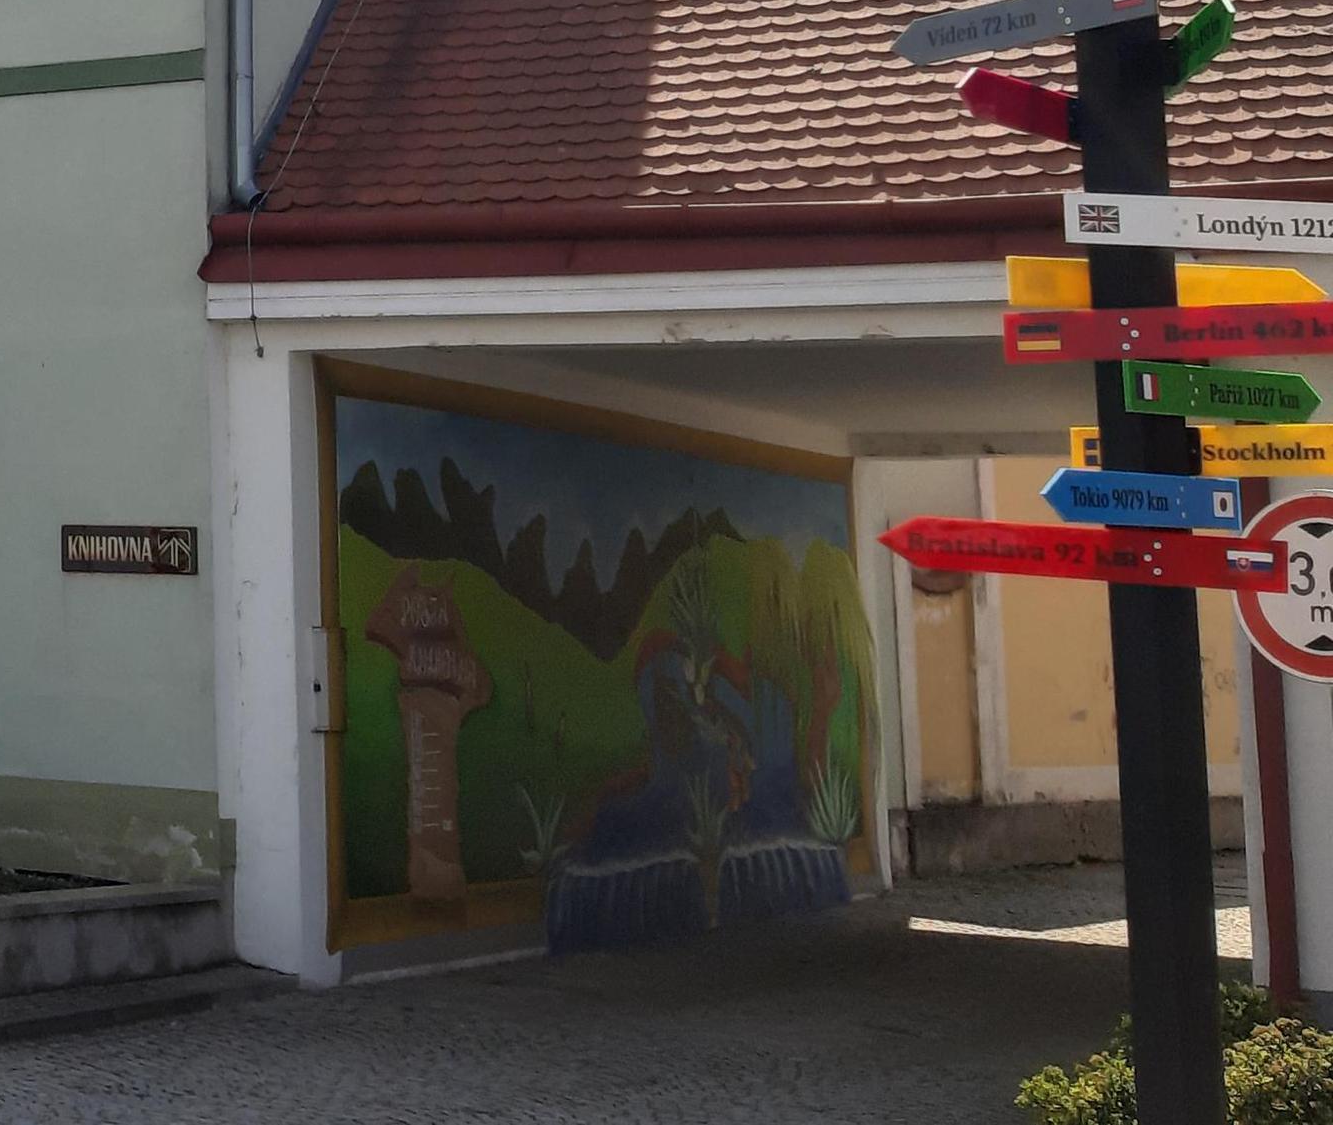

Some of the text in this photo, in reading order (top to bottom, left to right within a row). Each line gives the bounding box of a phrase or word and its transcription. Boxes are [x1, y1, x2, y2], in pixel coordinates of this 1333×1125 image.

[927, 12, 1036, 48] Vídeň 72 km
[1196, 214, 1286, 241] Londýn
[1163, 320, 1245, 343] Berlin
[1209, 383, 1301, 409] Paříž 1027 km
[1203, 441, 1326, 462] Stockholm
[1070, 486, 1169, 512] Tokio 9079 km
[67, 534, 154, 563] KNIHOVNA
[907, 531, 1139, 568] Bratislava 92 km
